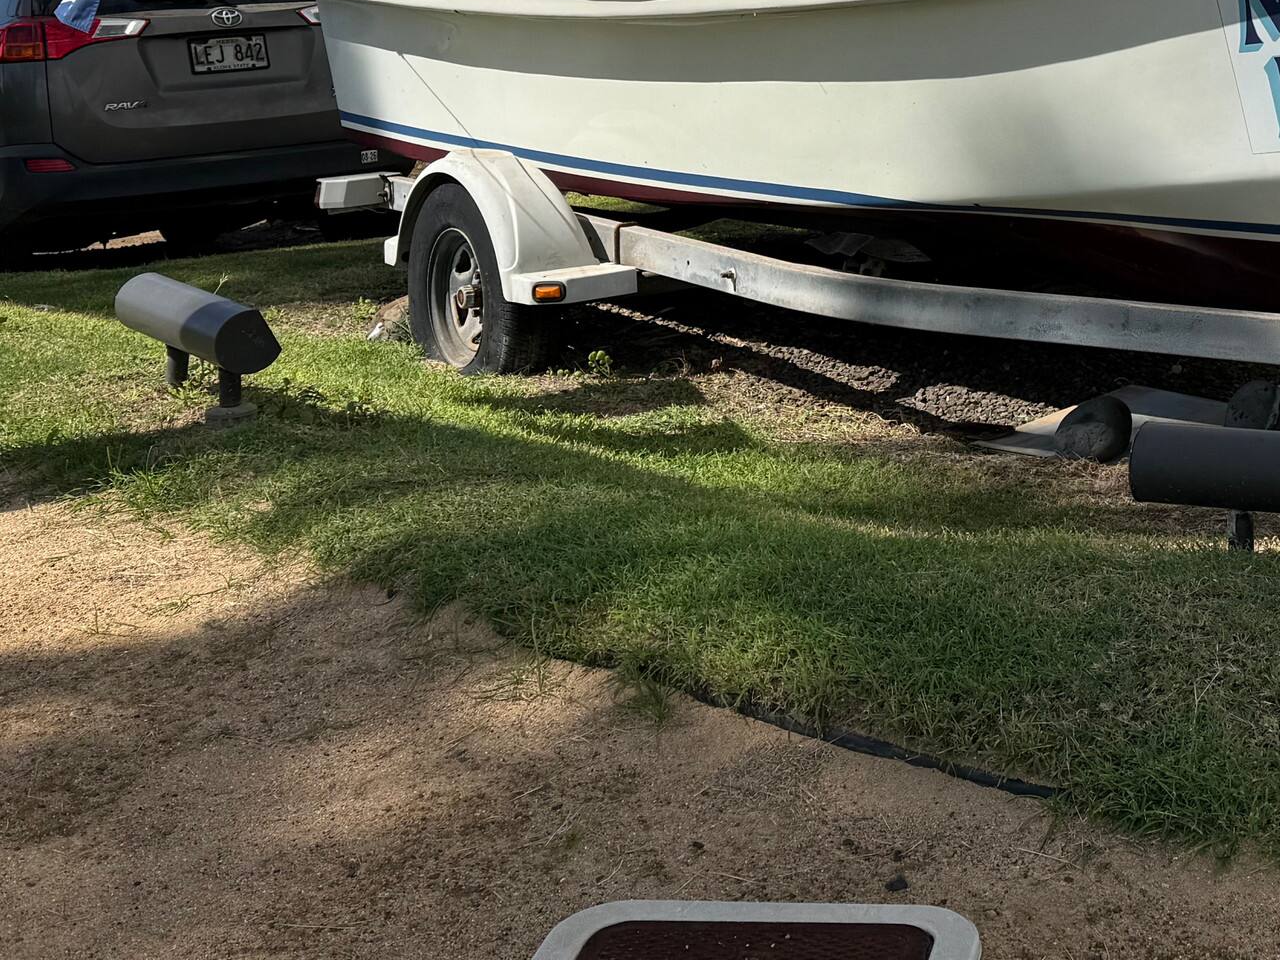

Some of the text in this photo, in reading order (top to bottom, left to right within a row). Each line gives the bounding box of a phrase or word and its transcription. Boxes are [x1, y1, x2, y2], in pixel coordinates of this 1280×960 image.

[193, 42, 265, 65] LEJ 842
[104, 100, 149, 111] RAV
